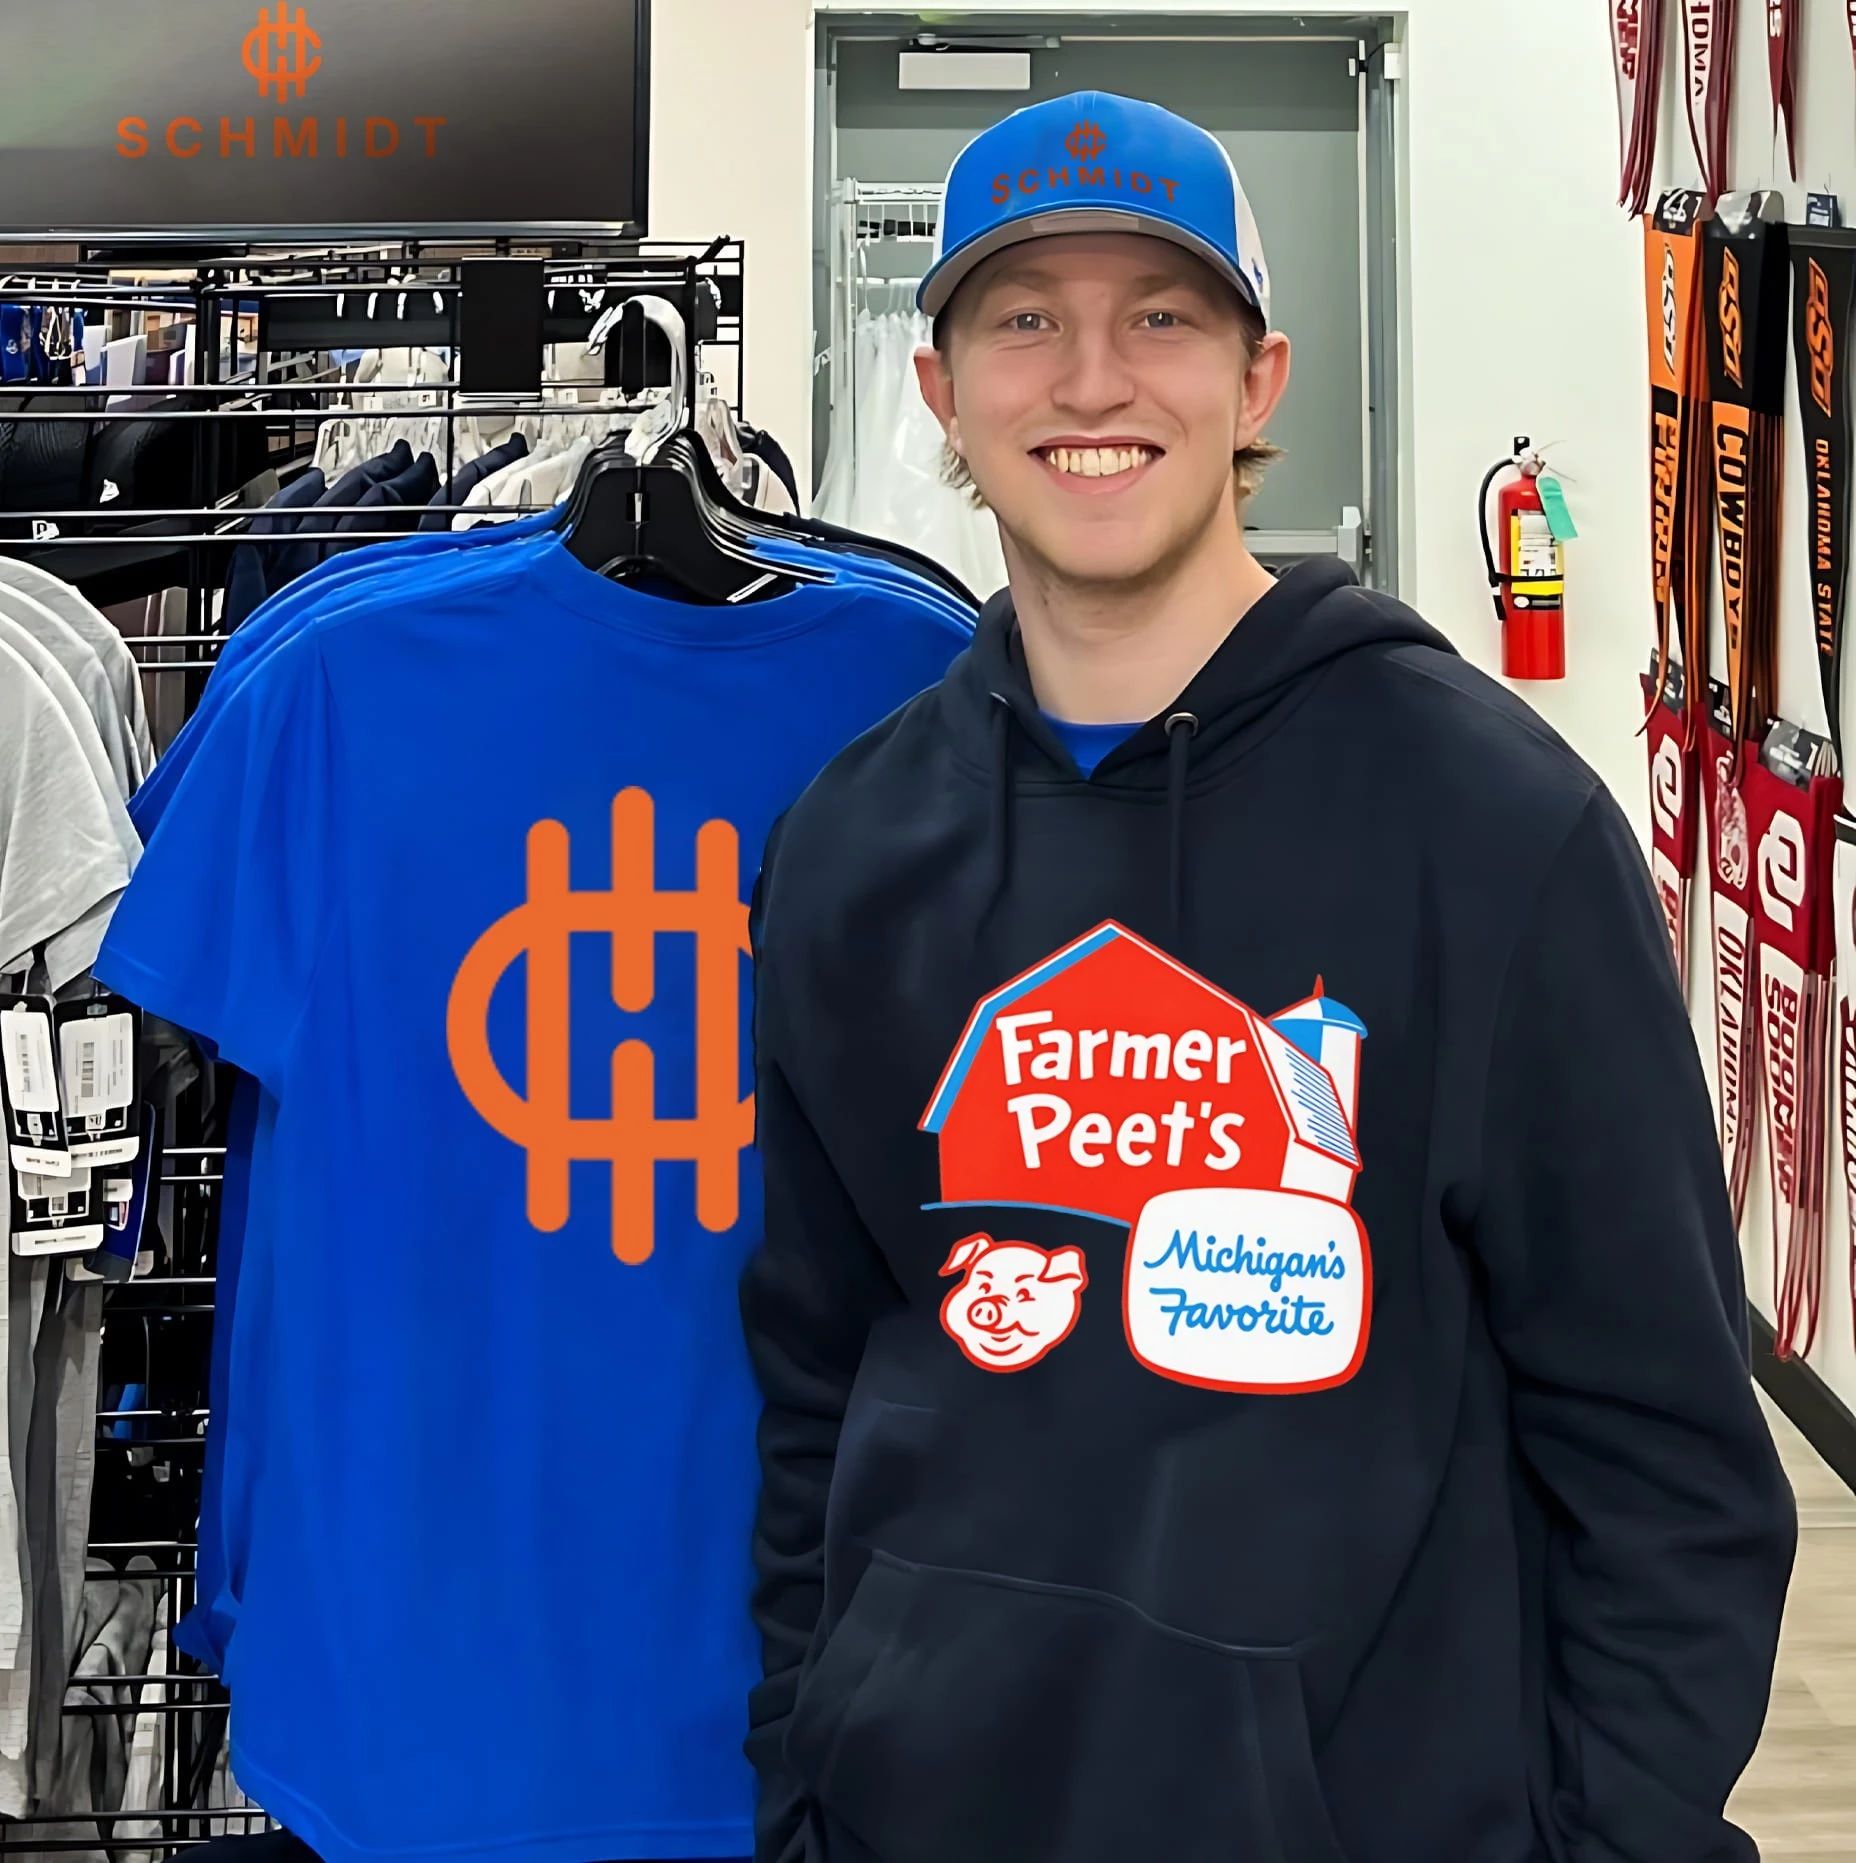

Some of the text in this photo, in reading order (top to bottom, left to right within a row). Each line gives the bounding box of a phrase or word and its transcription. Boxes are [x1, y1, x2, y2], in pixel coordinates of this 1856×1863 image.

[115, 116, 448, 159] SCHMIDT
[991, 166, 1181, 205] SCHMIDT
[1815, 438, 1832, 571] OKLAHOMA
[995, 1009, 1247, 1086] Farmer
[1718, 926, 1744, 1144] OKLAHOMA
[1007, 1093, 1246, 1171] Peet's
[1143, 1229, 1346, 1293] Michigan's
[1149, 1287, 1335, 1336] Favorite
